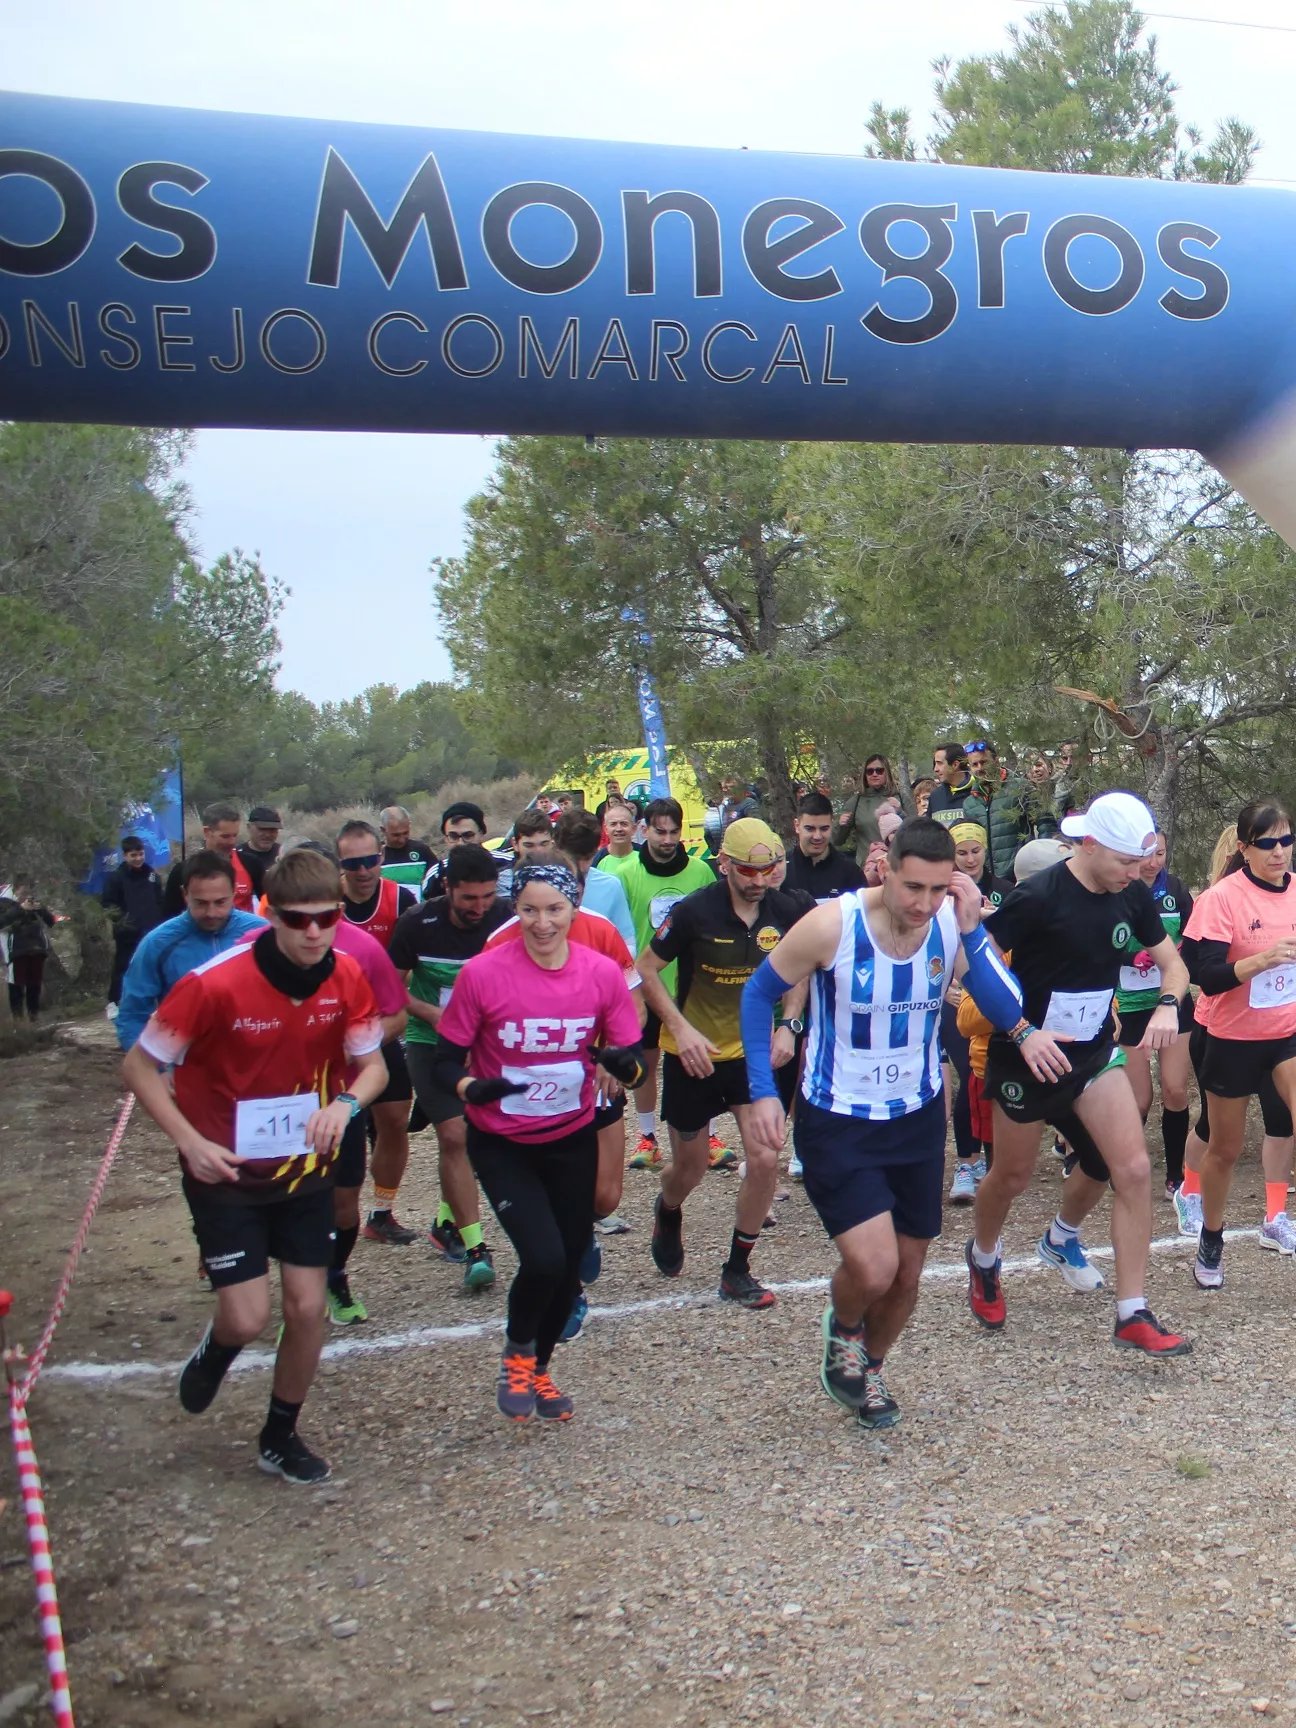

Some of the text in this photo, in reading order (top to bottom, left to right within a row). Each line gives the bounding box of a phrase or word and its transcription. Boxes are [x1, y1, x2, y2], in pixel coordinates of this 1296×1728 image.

[0, 144, 1230, 345] os Monegros
[0, 300, 848, 386] NSEJO COMARCAL
[1274, 975, 1285, 992] 8
[888, 1000, 941, 1013] GIPUZKO
[1078, 1004, 1087, 1024] 1
[871, 1063, 900, 1085] 19
[527, 1081, 558, 1101] 22
[267, 1113, 291, 1137] 11
